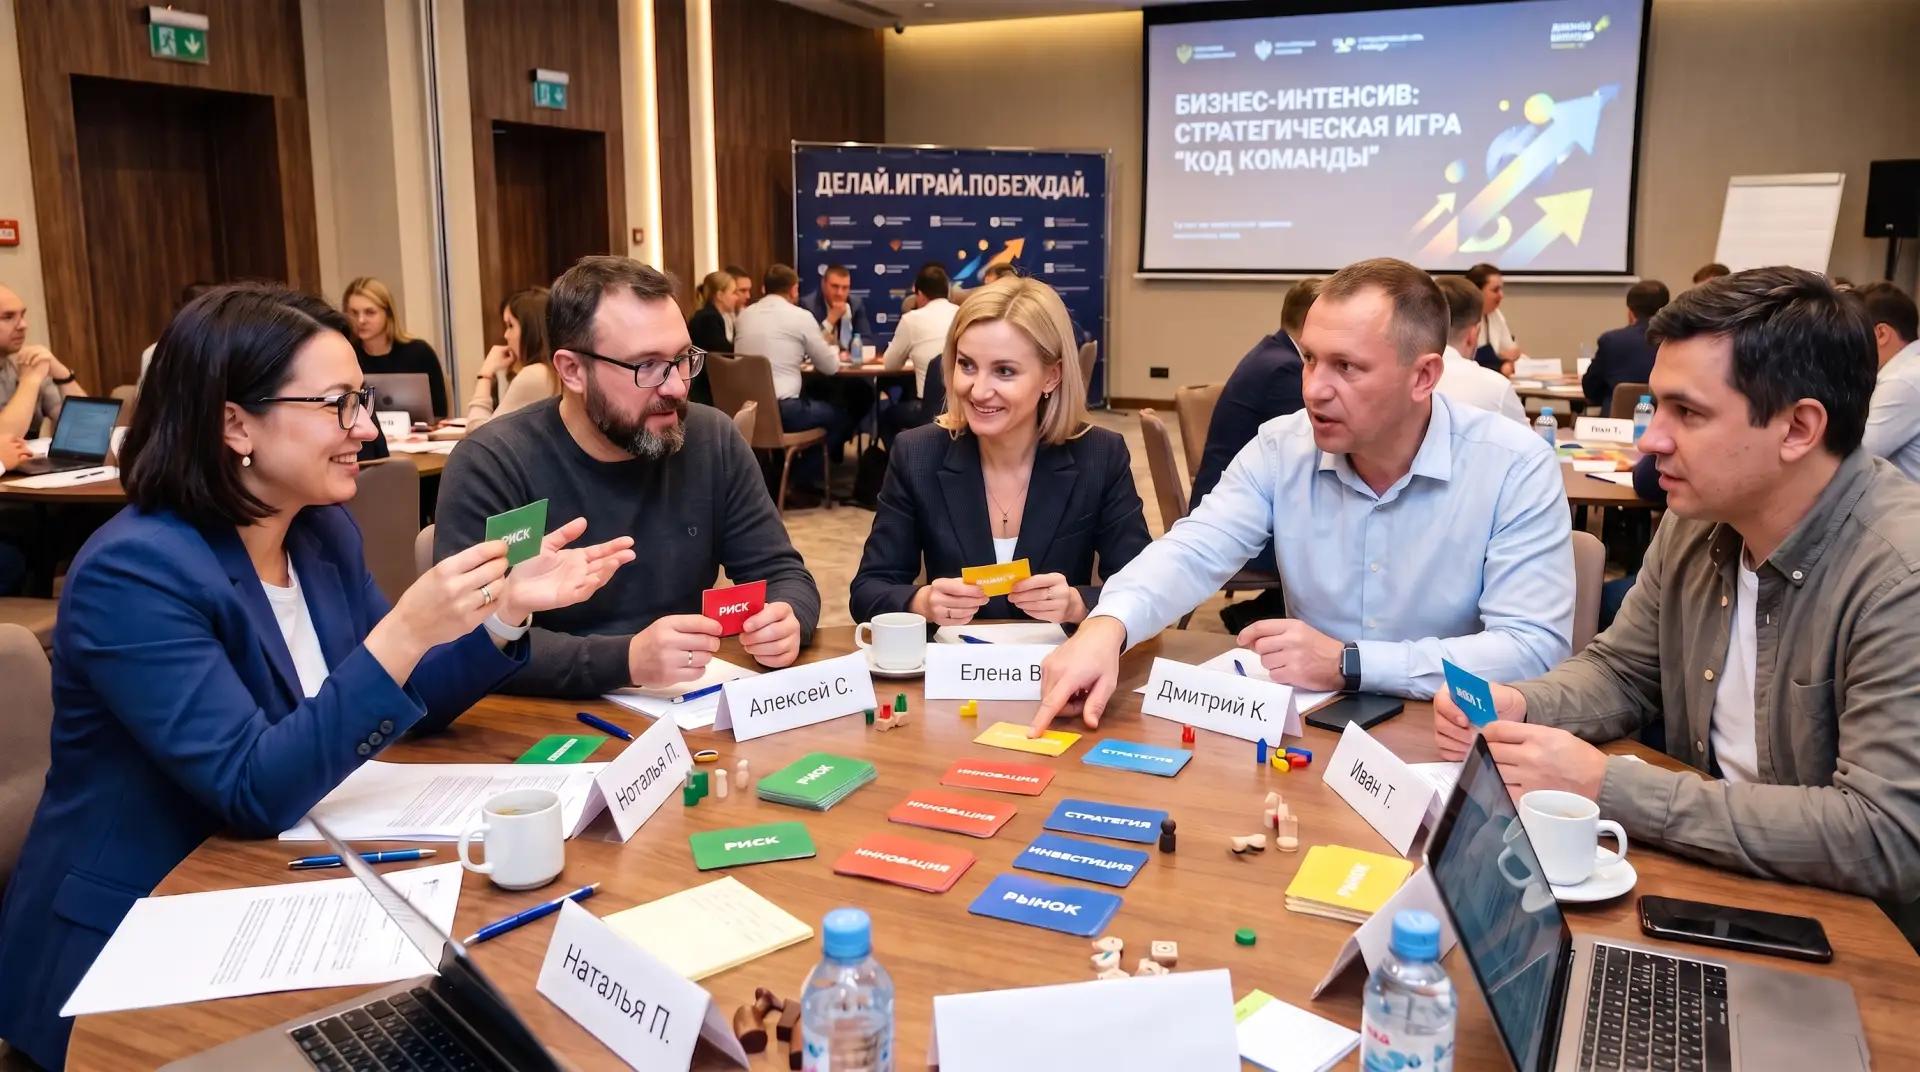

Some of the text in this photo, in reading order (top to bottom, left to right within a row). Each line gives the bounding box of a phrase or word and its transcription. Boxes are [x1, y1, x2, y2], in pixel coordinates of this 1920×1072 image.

[1175, 84, 1419, 115] БИЗНЕС-ИНТЕНСИВ:
[1174, 112, 1462, 144] СТРАТЕГИЧЕСКАЯ ИГРА
[815, 166, 1090, 200] ДЕЛАЙ.ИГРАЙ.ПОБЕЖДАЙ.
[719, 602, 750, 617] РИСК
[961, 663, 1021, 682] Елена
[750, 677, 853, 717] Алексей С.
[1157, 680, 1267, 722] Дмитрий К.
[615, 756, 667, 811] Ноталья
[664, 742, 680, 765] П.
[1350, 758, 1396, 809] Иван Т.
[1064, 811, 1152, 829] СТРАТЕГИЯ
[724, 836, 780, 851] РИСК
[1028, 846, 1135, 872] ИНВЕСТИЦИЯ
[1002, 891, 1082, 916] РЫНОК
[563, 943, 670, 1044] Наталья П.
